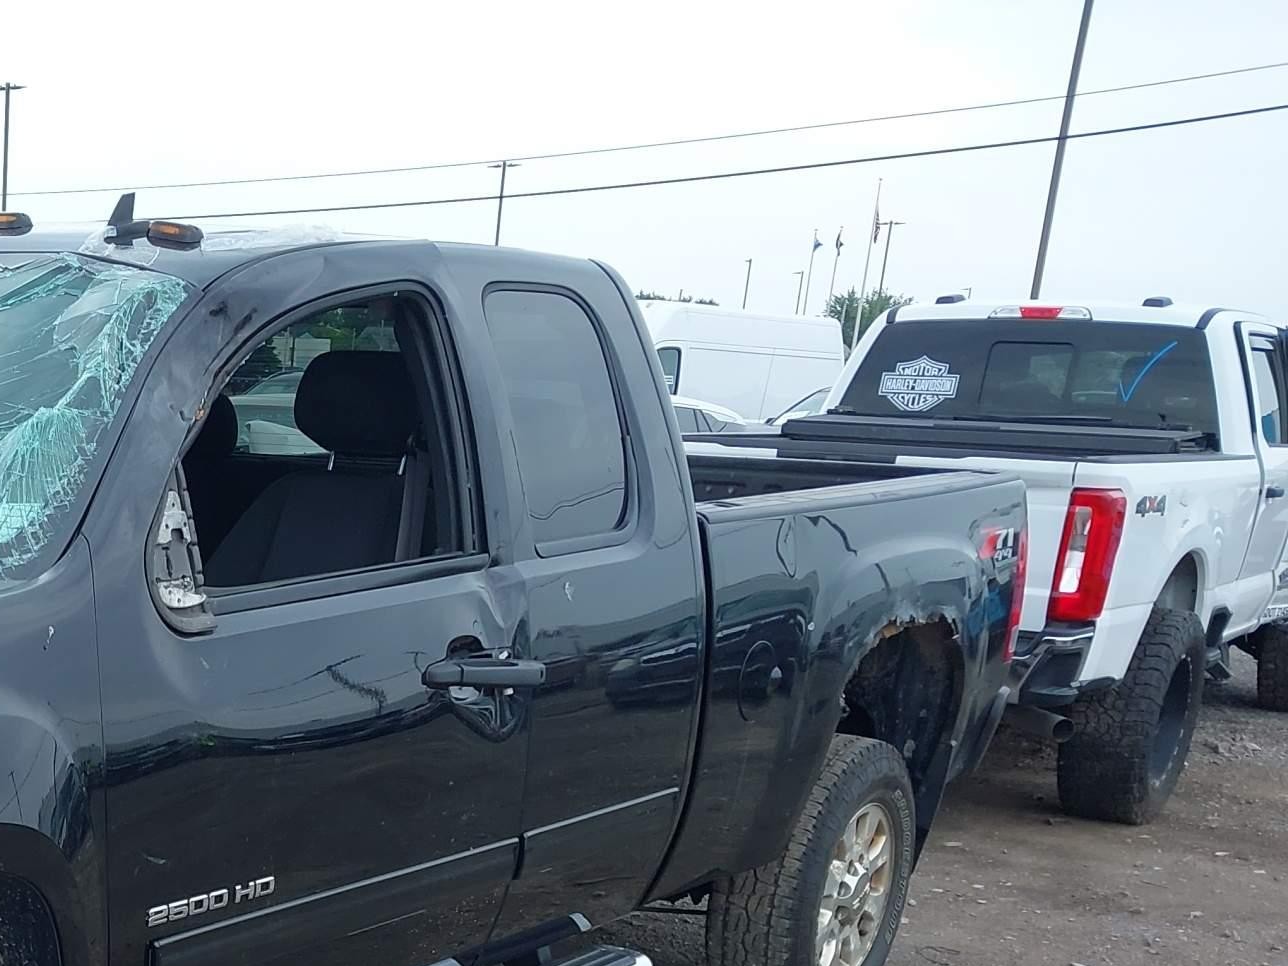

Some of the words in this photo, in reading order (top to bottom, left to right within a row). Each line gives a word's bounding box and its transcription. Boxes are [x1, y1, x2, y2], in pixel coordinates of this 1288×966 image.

[903, 363, 939, 376] MOTOR
[885, 378, 952, 391] HARLEY-DAVIDSON
[898, 393, 932, 408] CYCLES
[146, 888, 229, 927] 2500
[234, 876, 275, 903] HD
